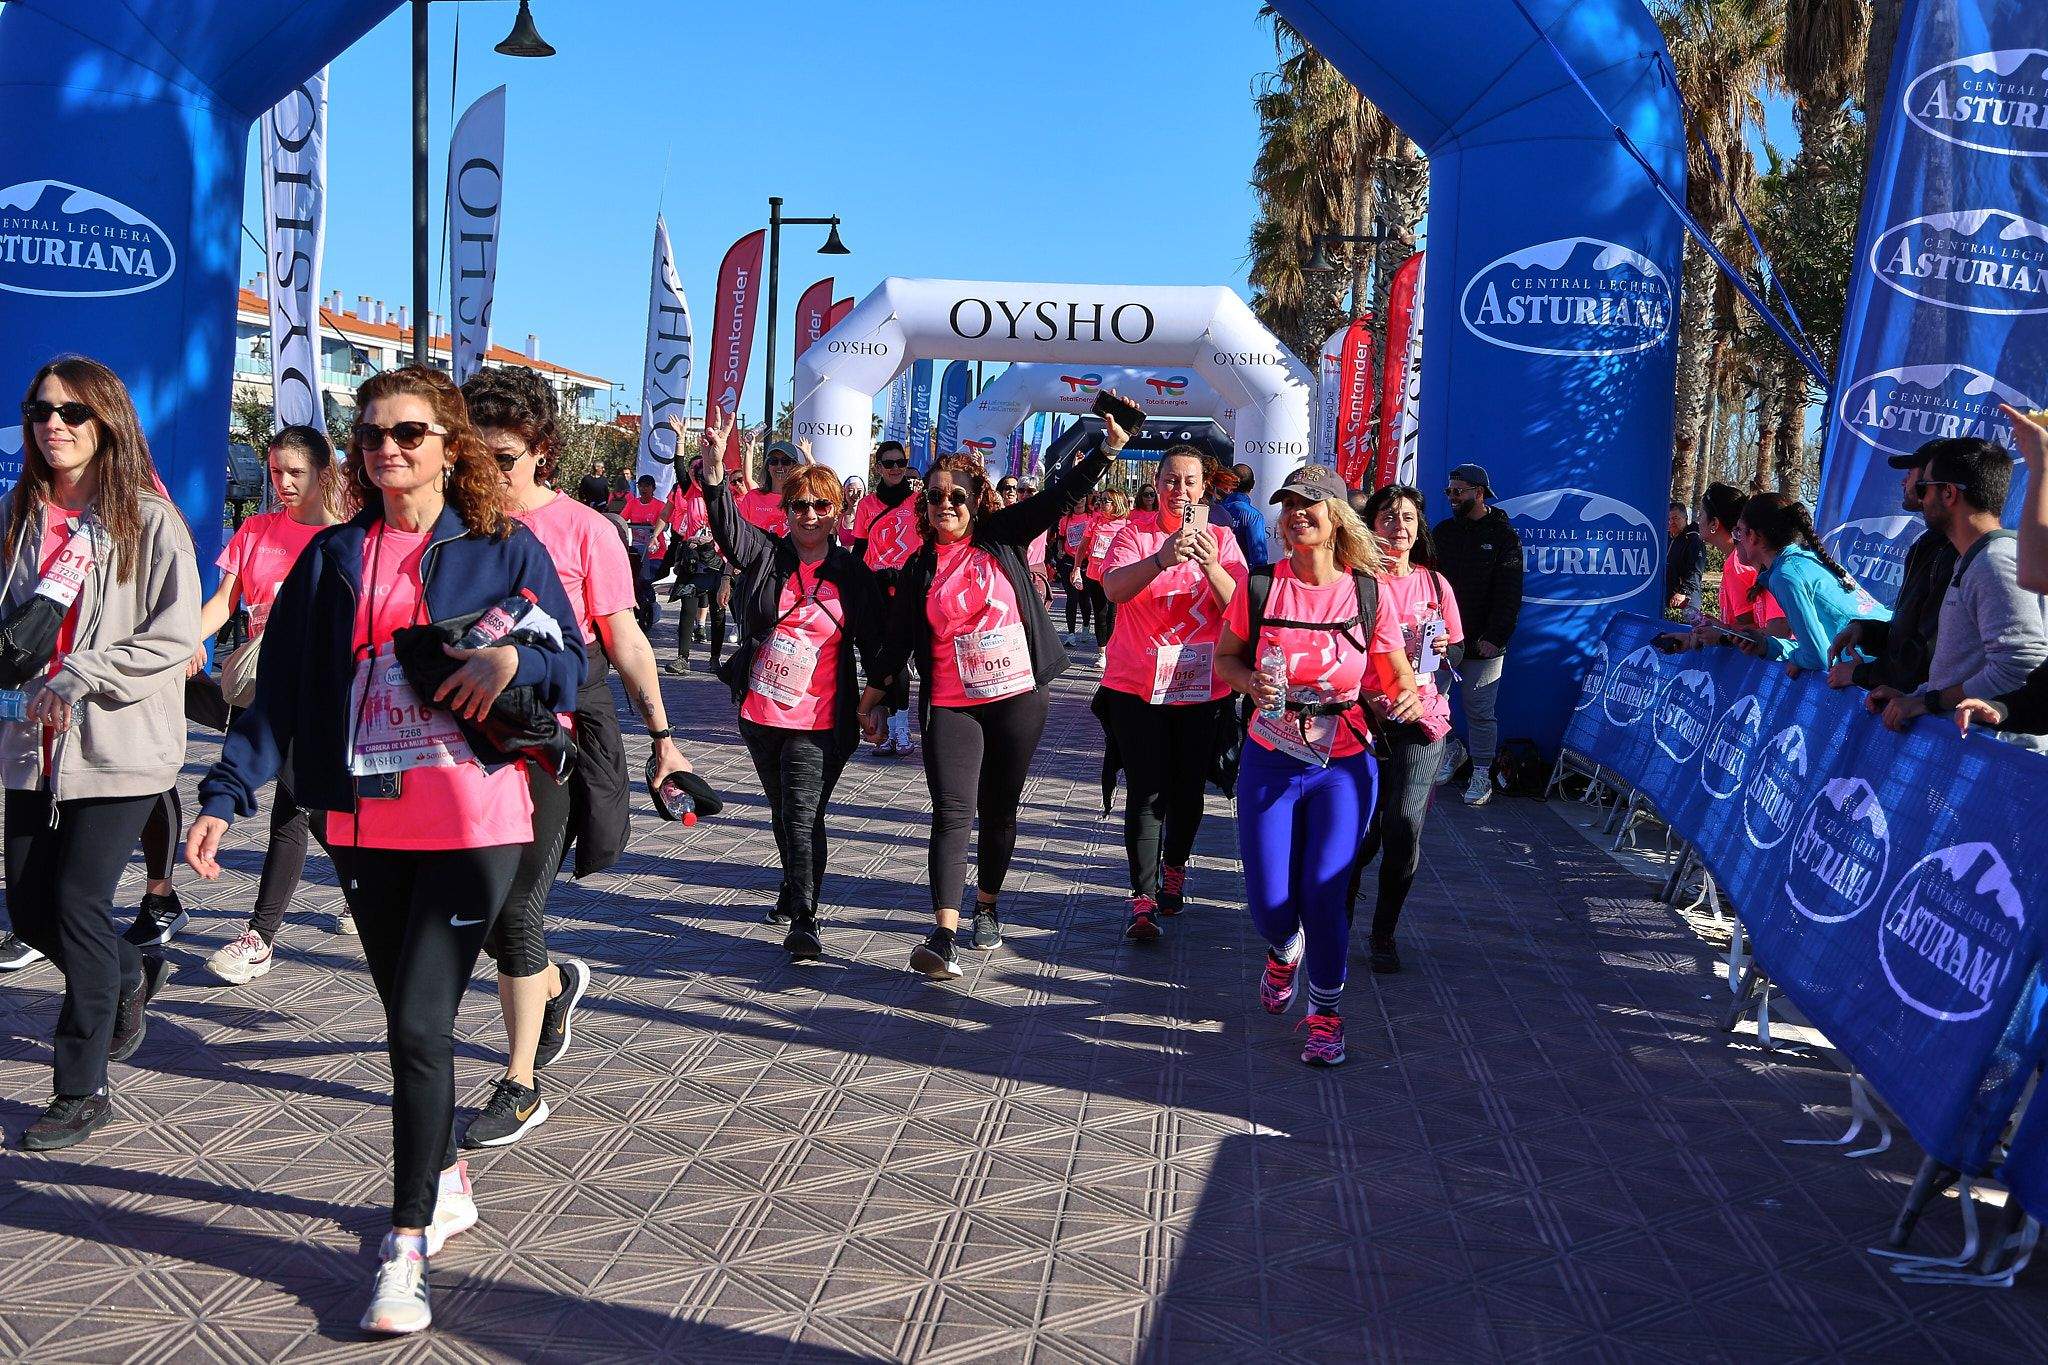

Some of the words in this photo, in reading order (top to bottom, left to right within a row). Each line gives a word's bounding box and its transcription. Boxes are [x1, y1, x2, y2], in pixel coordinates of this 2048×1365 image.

[1963, 80, 2035, 96] CENTRAL
[1918, 79, 2048, 130] ASTURI
[2, 218, 60, 231] ENTRAL
[68, 222, 151, 243] LECHERA
[0, 233, 158, 278] TURIANA
[1924, 237, 1995, 256] CENTRAL
[2001, 247, 2045, 262] LECH
[1883, 236, 2048, 294] ASTURIAN
[1512, 278, 1591, 289] CENTRAL
[1599, 279, 1662, 294] LECHERA
[1474, 281, 1665, 329] ASTURIANA
[723, 266, 749, 384] Santander
[949, 298, 1155, 344] OYSHO
[828, 340, 888, 356] OYSHO
[1213, 352, 1276, 366] OYSHO
[1347, 340, 1368, 433] Santander
[1059, 395, 1096, 404] TotalEnerg
[1889, 390, 1959, 410] CENTRAL
[1965, 402, 2010, 420] LECH
[911, 383, 930, 448] Marlene
[937, 394, 958, 453] Marlene
[1852, 388, 2017, 451] ASTURIAN
[797, 421, 853, 437] OYSHO
[1101, 428, 1192, 440] VLVO
[1245, 440, 1302, 455] OYSHO
[1513, 528, 1578, 540] NTRAL
[1586, 530, 1648, 542] LECHERA
[1853, 540, 1906, 559] CENTRAL
[1521, 544, 1651, 576] TURIANA
[1830, 539, 1905, 587] ASTUR
[59, 566, 79, 581] 7270
[764, 659, 790, 677] 016
[984, 656, 1011, 672] 016
[1174, 670, 1195, 681] 016
[389, 704, 433, 726] 016
[1284, 709, 1312, 730] 06
[399, 728, 422, 739] 7268
[365, 743, 391, 752] CARRERA
[391, 742, 400, 750] DE
[400, 740, 409, 748] LA
[409, 739, 428, 748] MUJER
[364, 755, 402, 768] OYSHO
